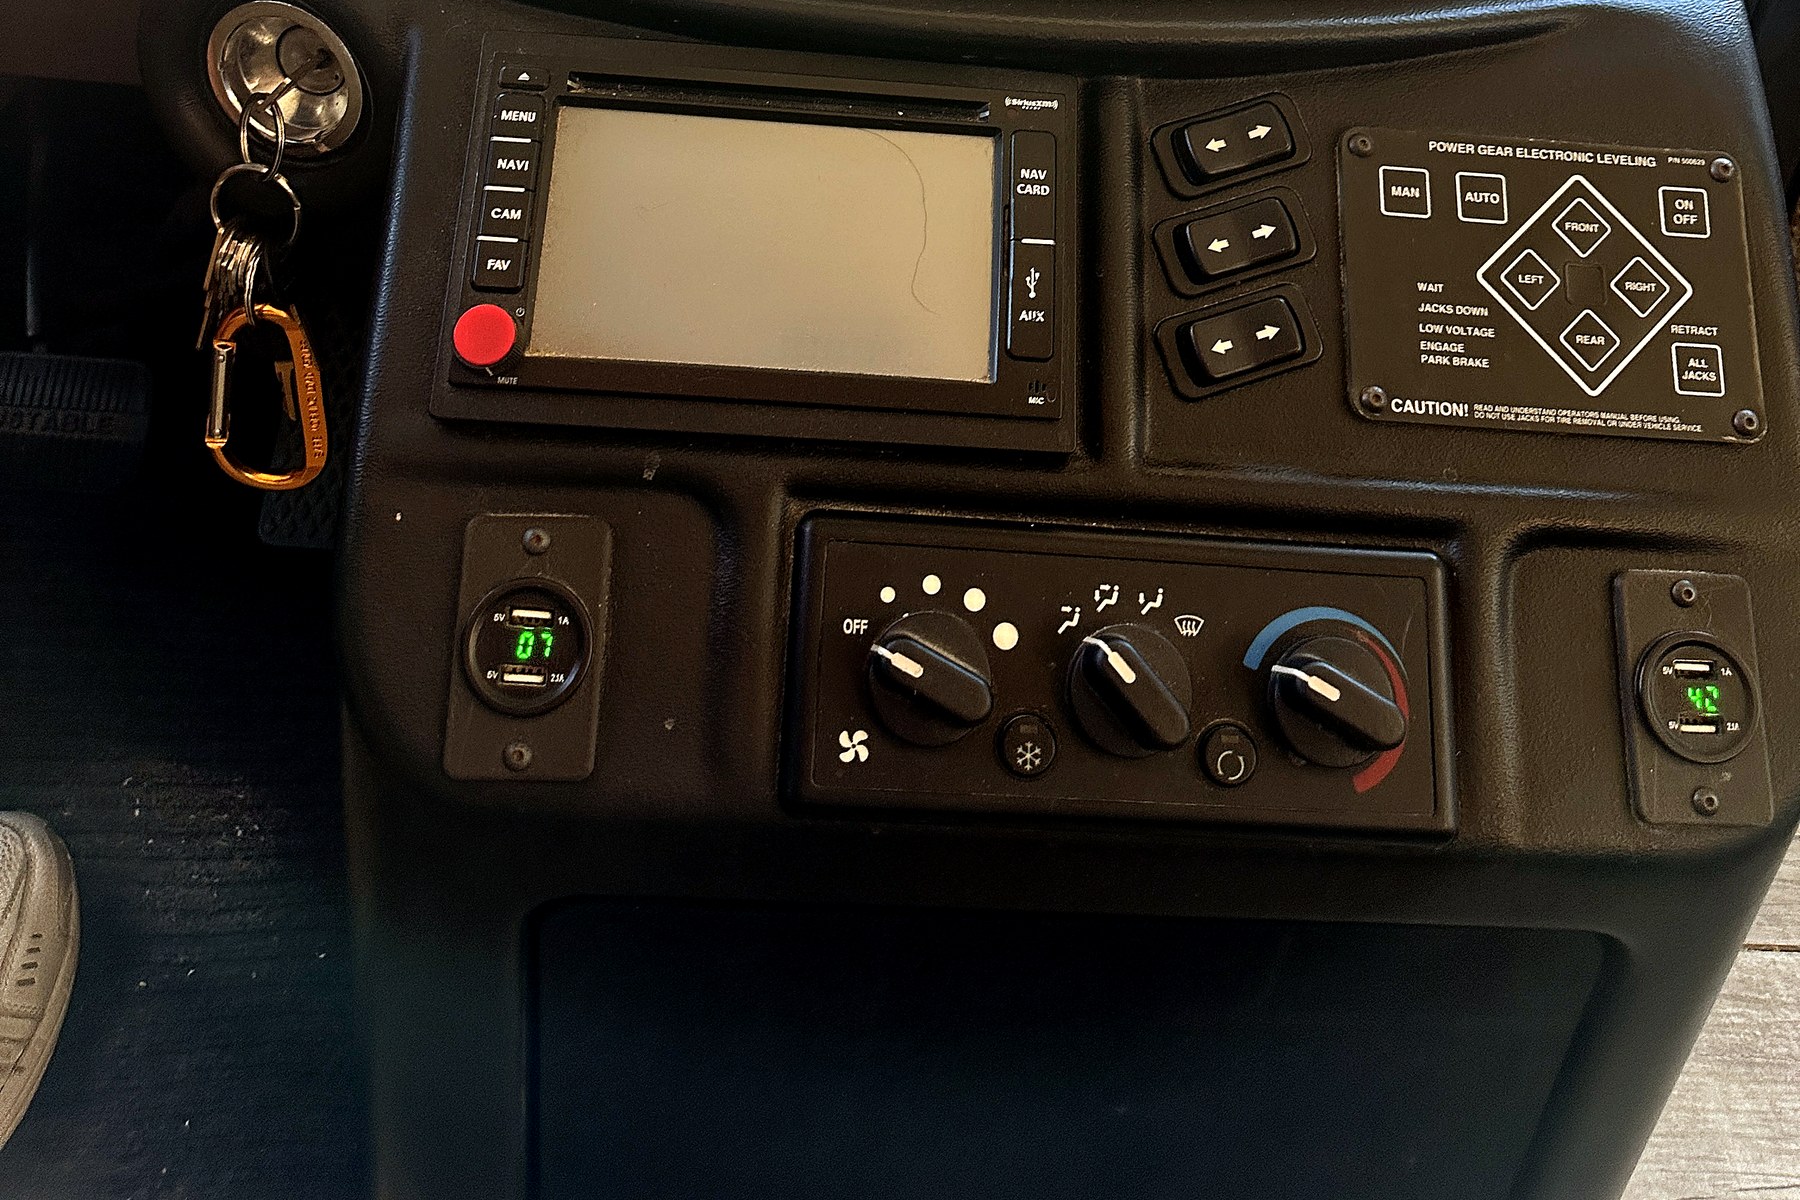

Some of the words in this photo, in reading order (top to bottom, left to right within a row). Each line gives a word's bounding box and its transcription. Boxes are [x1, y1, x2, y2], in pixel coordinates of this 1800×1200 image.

[500, 110, 536, 122] MENU
[1428, 141, 1475, 154] POWER
[1477, 144, 1514, 157] GEAR
[1516, 148, 1594, 163] ELECTRONIC
[1597, 154, 1657, 167] LEVELING
[496, 158, 530, 171] NAVI
[1020, 168, 1047, 180] NAV
[1016, 183, 1050, 196] CARD
[1391, 186, 1420, 198] MAN
[1464, 192, 1500, 204] AUTO
[1674, 199, 1694, 210] ON
[490, 208, 522, 220] CAM
[1673, 214, 1698, 225] OFF
[1564, 221, 1600, 233] FRONT
[486, 259, 511, 271] FAV
[1518, 274, 1545, 284] LEFT
[1417, 282, 1444, 292] WAIT
[1624, 281, 1657, 292] RIGHT
[1018, 309, 1045, 322] AUX
[1418, 303, 1453, 314] JACKS
[1455, 306, 1489, 317] DOWN
[1418, 323, 1444, 334] LOW
[1445, 325, 1496, 338] VOLTAGE
[1670, 325, 1718, 336] RETRACT
[1576, 335, 1605, 345] REAR
[1420, 341, 1465, 353] ENGAGE
[1420, 355, 1451, 365] PARK
[1452, 357, 1490, 368] BRAKE
[1687, 358, 1708, 368] ALL
[497, 376, 518, 385] MUTE
[1682, 371, 1717, 382] JACKS
[1028, 396, 1045, 405] MIC
[1390, 398, 1469, 417] CAUTION!
[1473, 404, 1494, 412] READ
[1494, 405, 1510, 413] AND
[1510, 406, 1557, 416] UNDERSTAND
[1600, 412, 1629, 421] MANUAL
[1630, 414, 1657, 422] BEFORE
[1474, 411, 1485, 419] DO
[1486, 412, 1500, 420] NOT
[1501, 413, 1516, 421] USE
[1517, 414, 1540, 423] JACKS
[1540, 415, 1555, 423] FOR
[1572, 417, 1606, 427] REMOVAL
[1618, 420, 1642, 429] UNDER
[1643, 422, 1672, 431] VEHICLE
[558, 616, 570, 625] 1A
[843, 618, 868, 634] OFF
[1721, 667, 1733, 676] 1A
